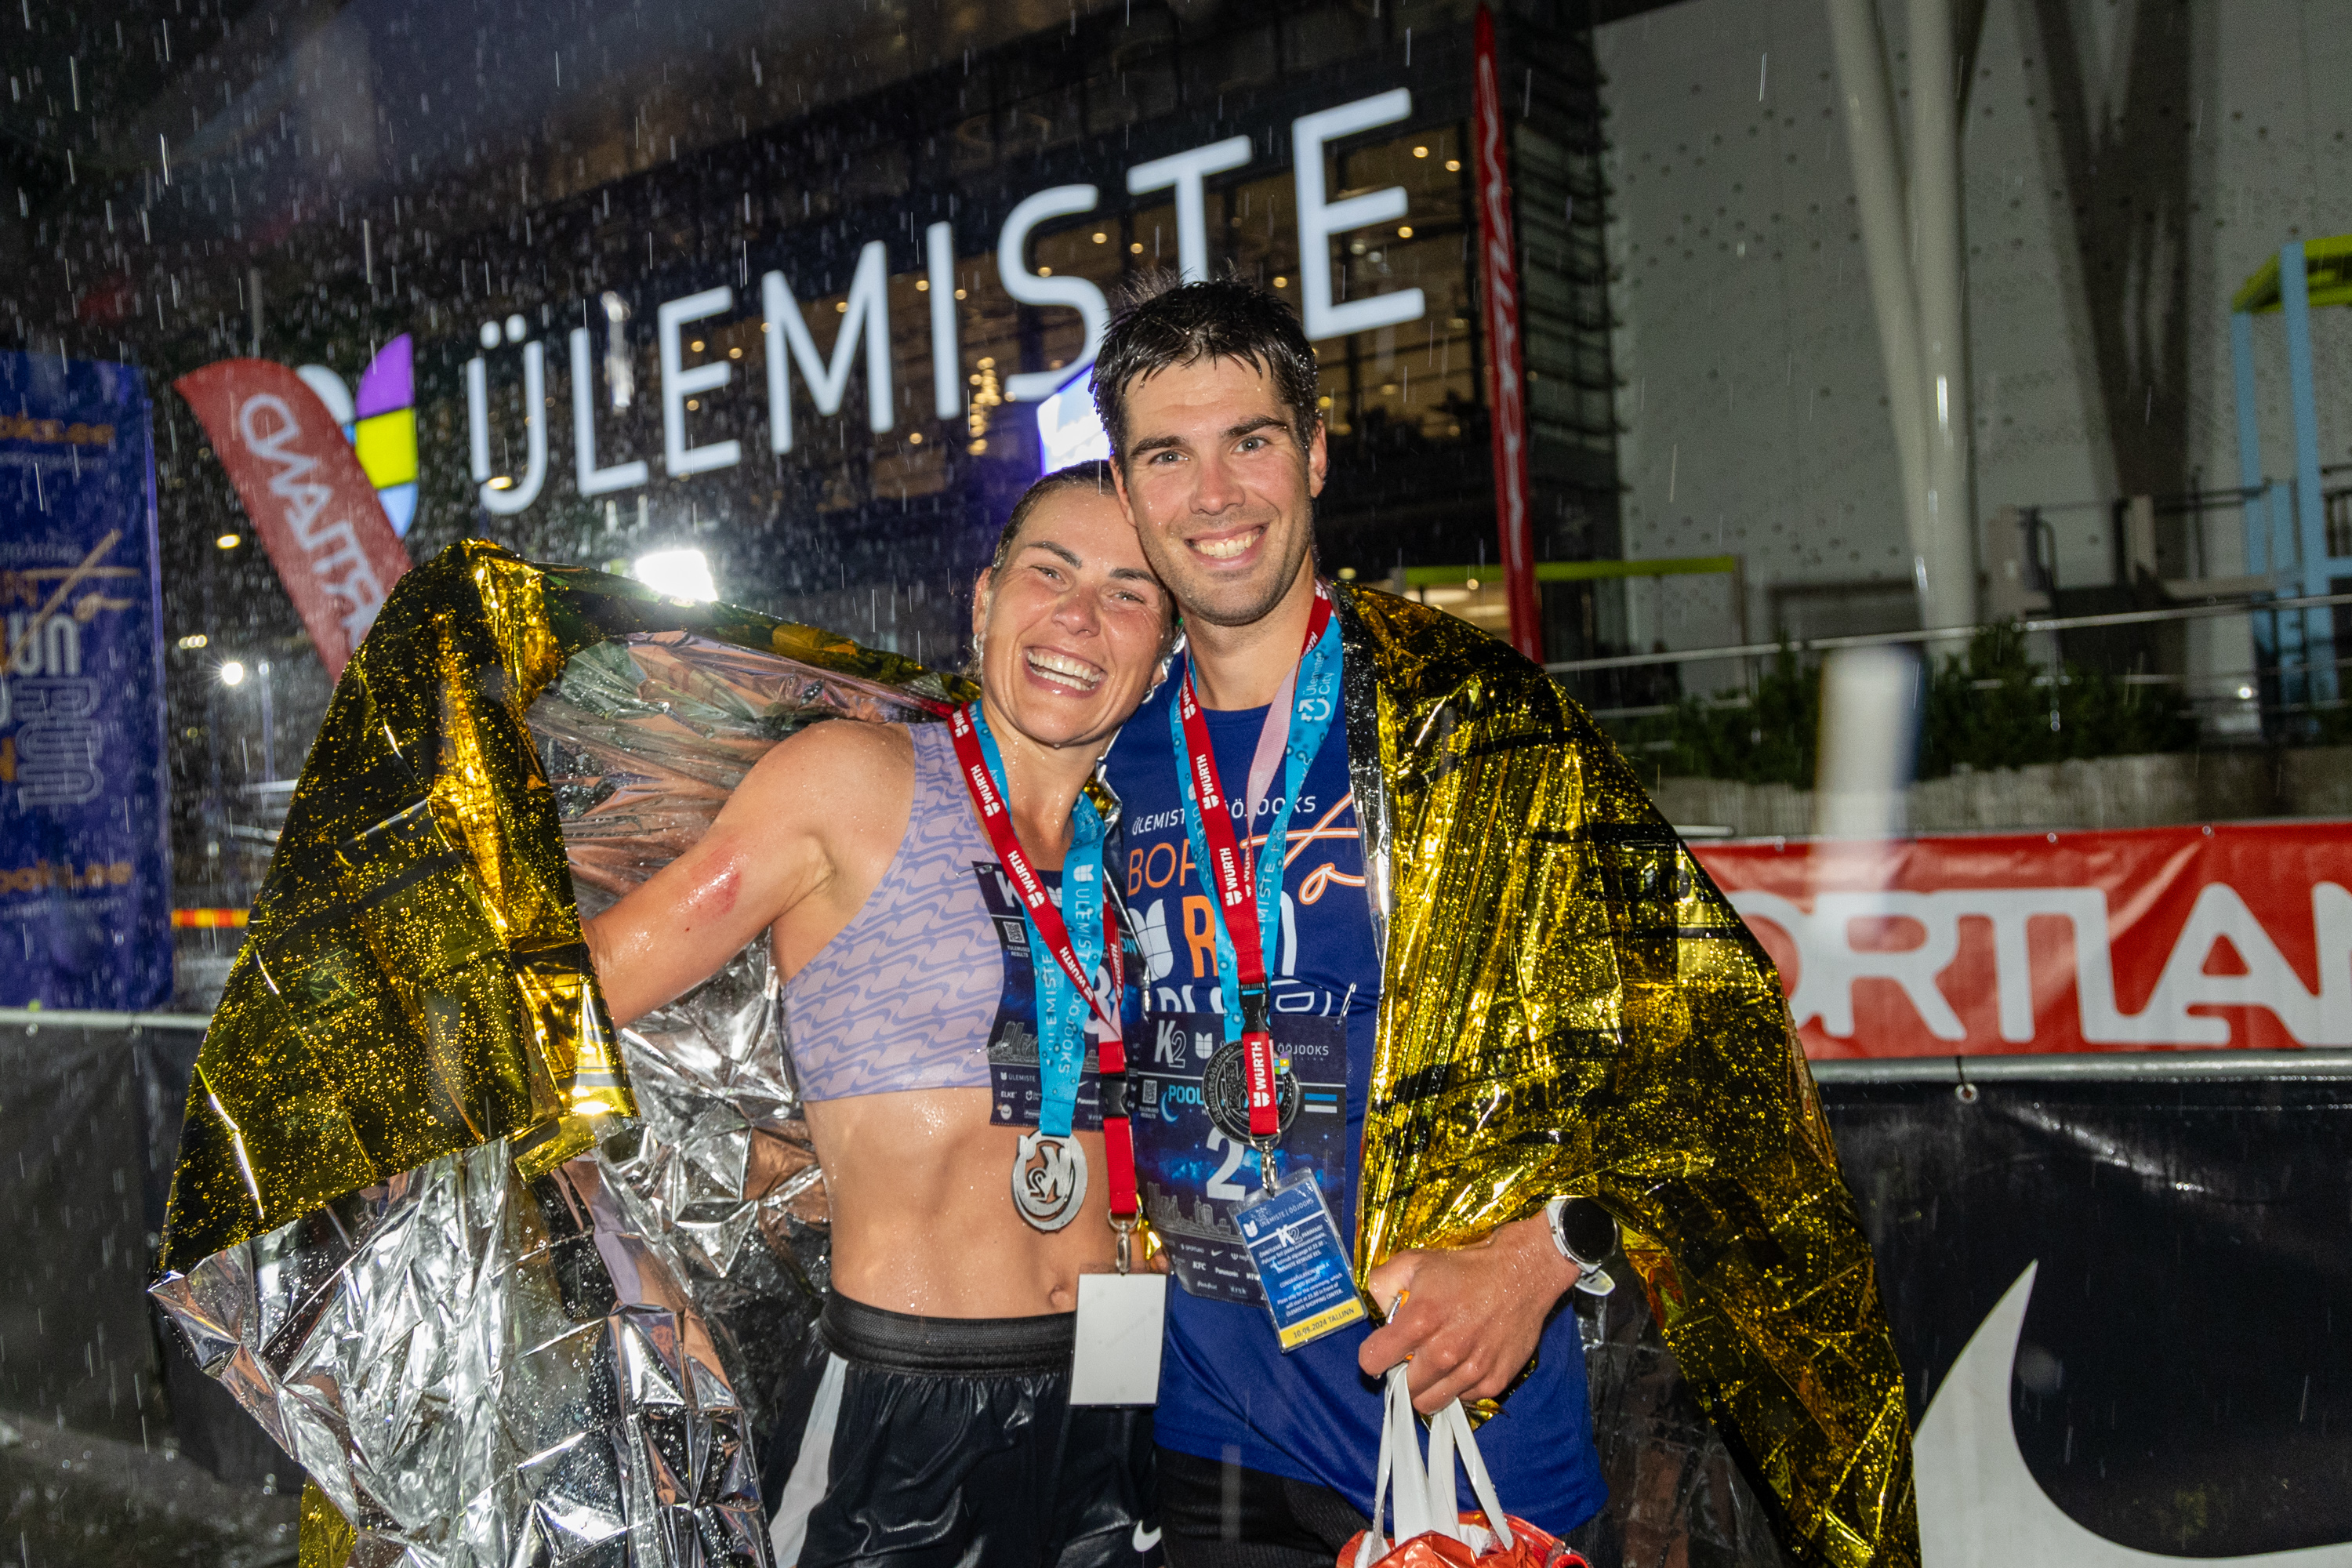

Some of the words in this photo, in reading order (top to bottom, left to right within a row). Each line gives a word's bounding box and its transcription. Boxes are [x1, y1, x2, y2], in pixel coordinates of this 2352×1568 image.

[466, 86, 1425, 516] ÜLEMISTE
[1301, 630, 1318, 661] RTH
[1302, 655, 1325, 696] Ülemiste
[1318, 672, 1334, 695] City
[970, 763, 995, 804] WÜRTH
[1196, 753, 1215, 796] WÜRTH
[1131, 808, 1186, 836] ÜLEMIST
[1224, 795, 1317, 820] ÖOOKS
[1007, 849, 1037, 894] WÜRTH
[1218, 847, 1239, 891] WÜRTH
[1059, 946, 1087, 988] WÜRTH
[1154, 1019, 1187, 1069] K2
[1277, 1042, 1330, 1056] ÖÖJOOKS
[1008, 1074, 1036, 1083] ÜLEMISTE
[1250, 1040, 1267, 1091] WÜRTH
[1205, 1127, 1247, 1201] 2
[1276, 1224, 1303, 1247] K2
[1192, 1261, 1207, 1271] KFC
[1214, 1267, 1239, 1278] Panasonic
[1330, 1272, 1342, 1281] which
[1305, 1296, 1326, 1308] SHOPPING
[1328, 1307, 1355, 1323] TALLINN
